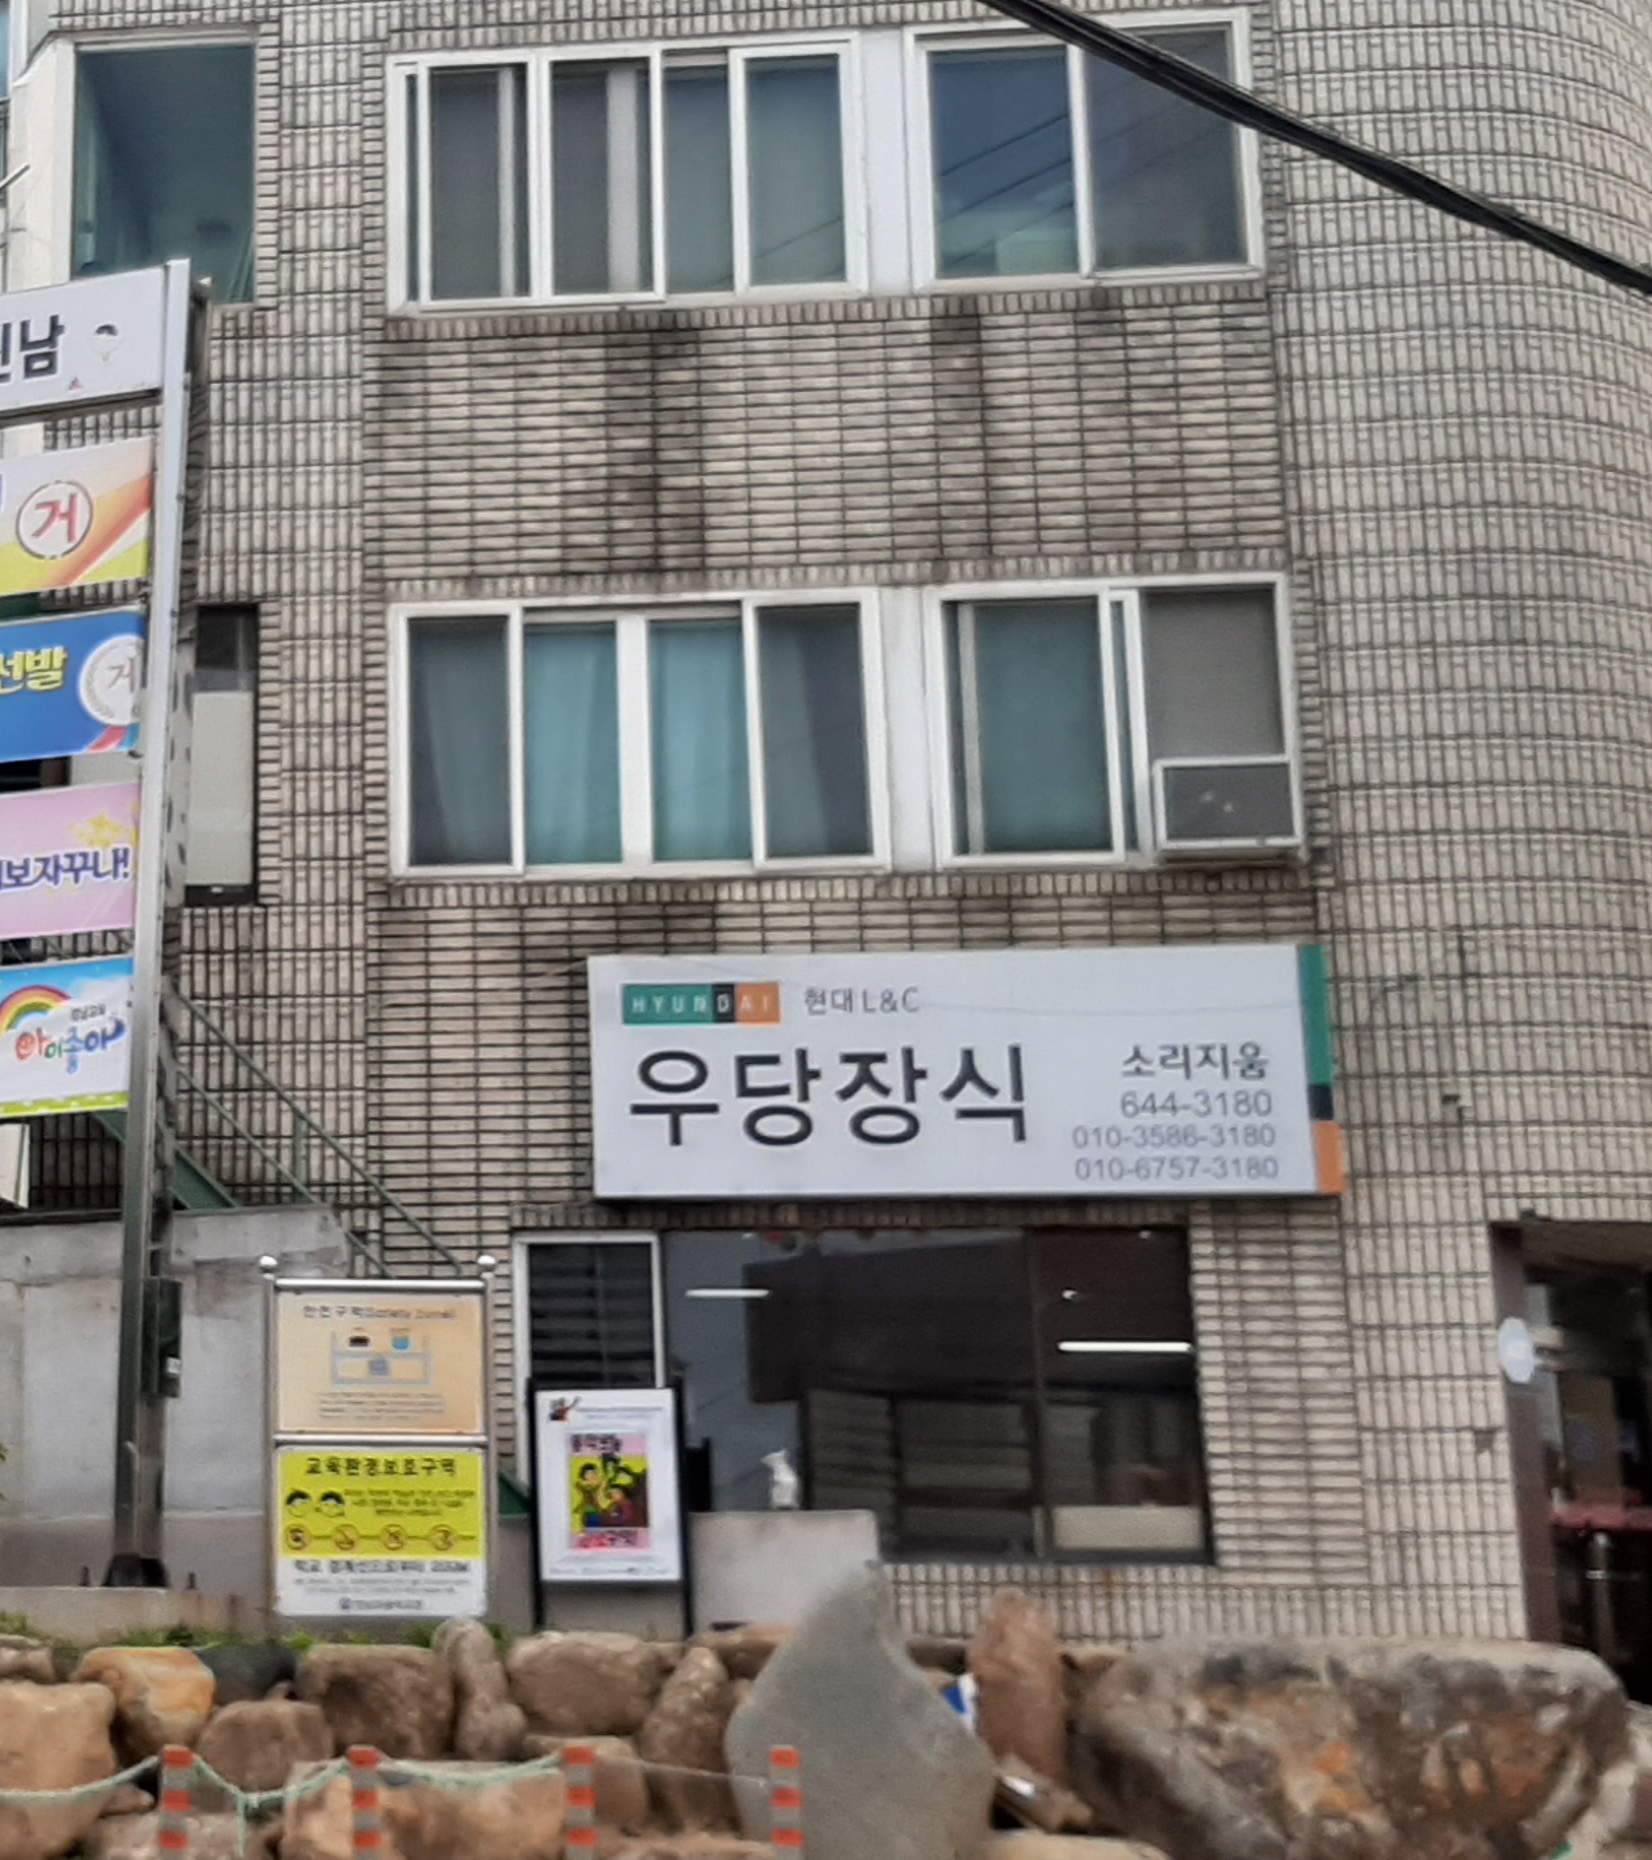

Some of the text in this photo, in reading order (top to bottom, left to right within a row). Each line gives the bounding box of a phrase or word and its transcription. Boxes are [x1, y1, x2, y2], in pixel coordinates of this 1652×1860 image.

[34, 492, 80, 544] 거
[631, 993, 770, 1016] HYUNDAI
[15, 1017, 126, 1075] 아이좋아
[1121, 1040, 1270, 1081] 소리지움
[630, 1042, 1027, 1147] 우당장식
[1121, 1089, 1273, 1118] 644-3180
[1072, 1122, 1277, 1149] 010-3586-3180
[1074, 1155, 1280, 1181] 010-6757-3180
